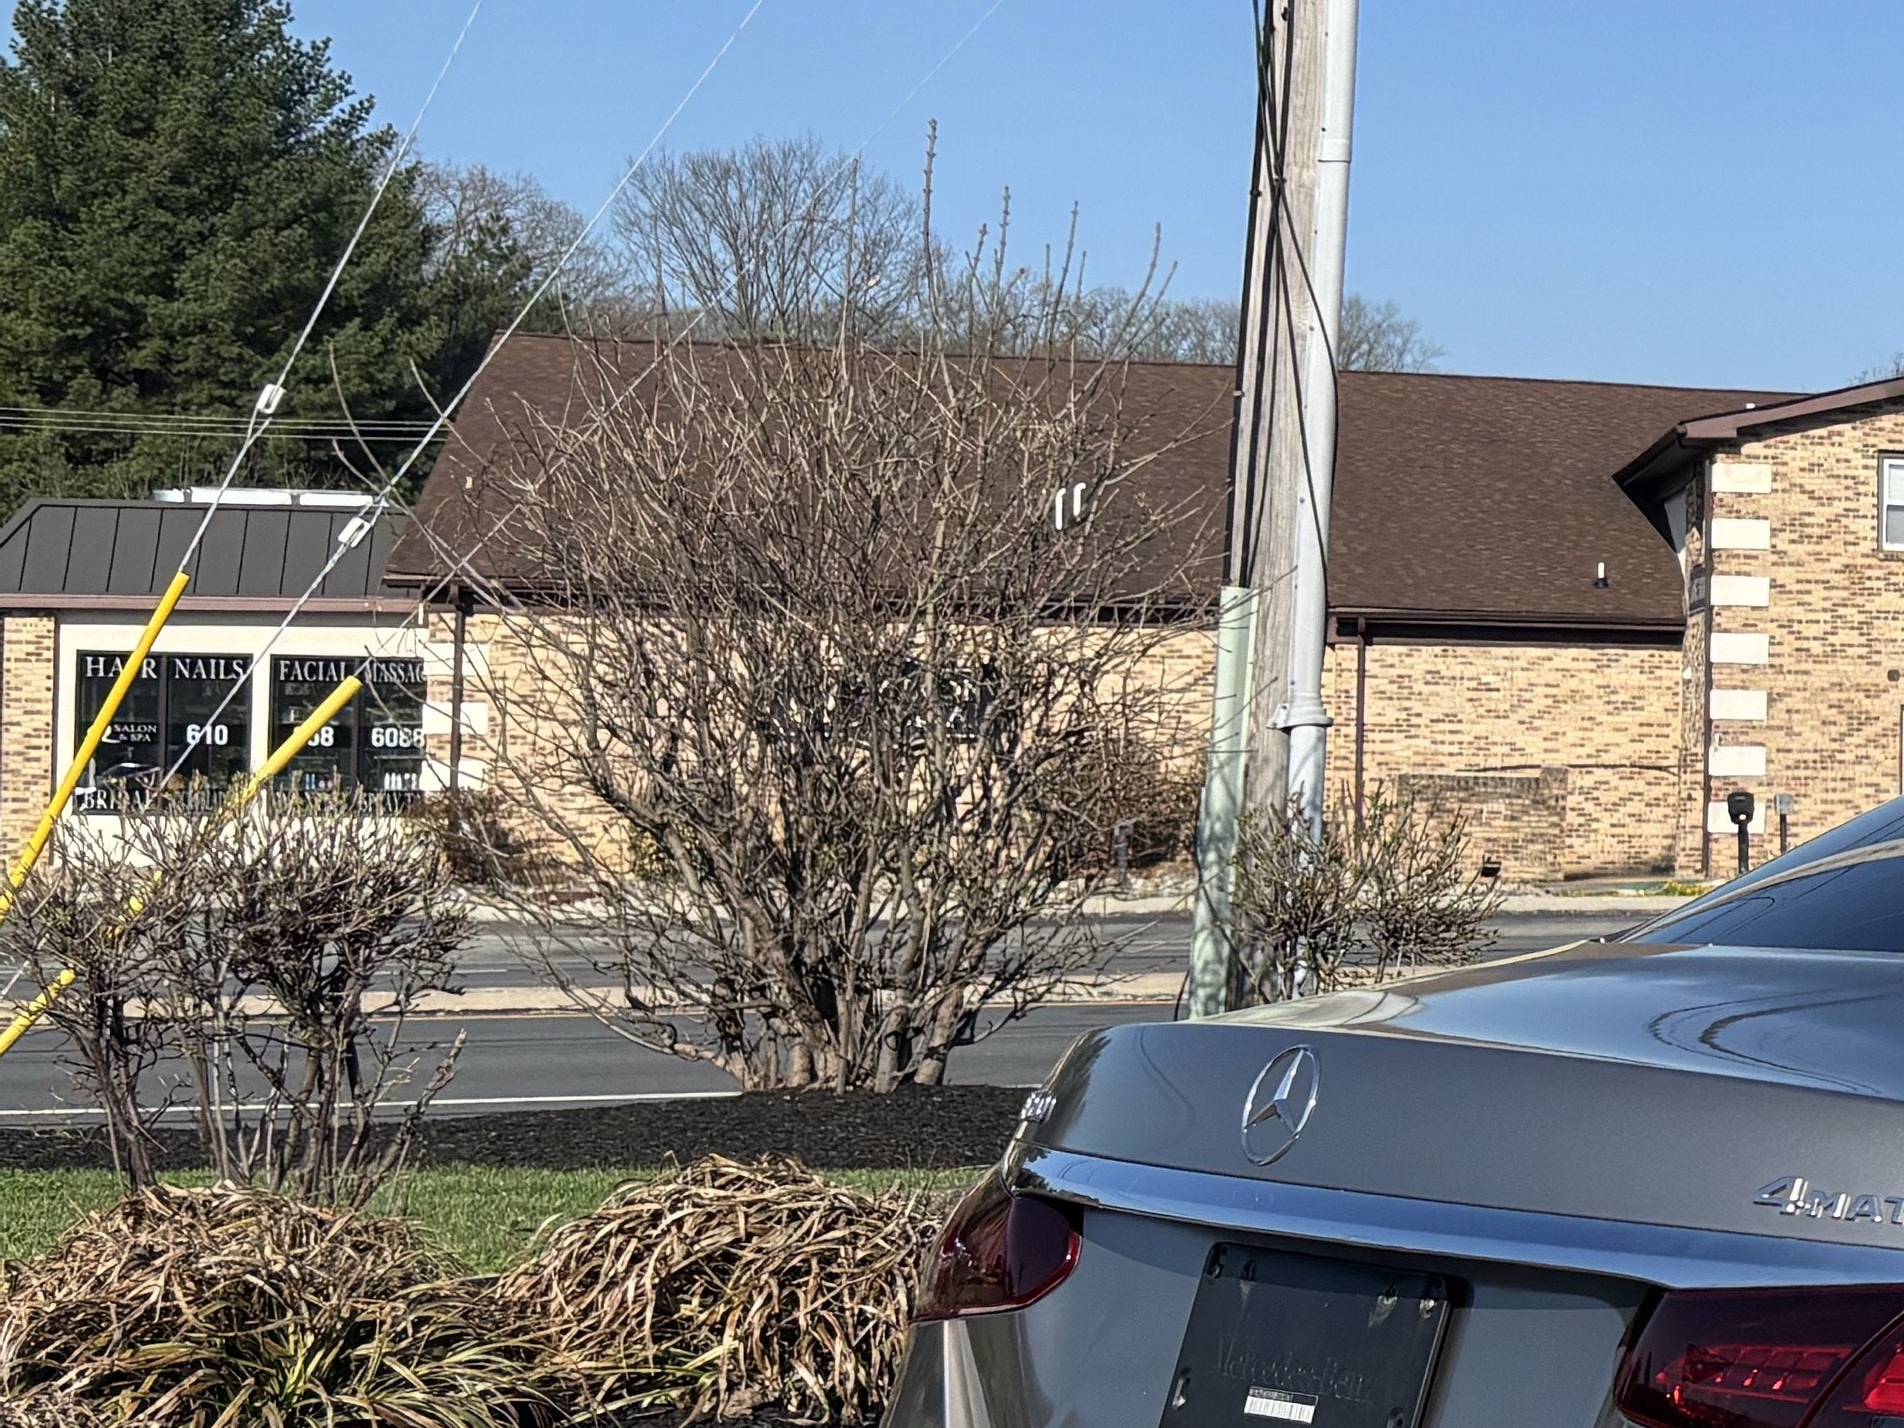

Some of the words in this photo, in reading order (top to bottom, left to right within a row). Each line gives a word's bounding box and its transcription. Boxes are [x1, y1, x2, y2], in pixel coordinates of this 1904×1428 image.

[85, 656, 158, 679] HAR
[174, 658, 246, 680] NAILS
[114, 723, 157, 733] SALON
[130, 733, 152, 742] SPA
[186, 723, 229, 746] 610
[371, 727, 425, 748] 6088
